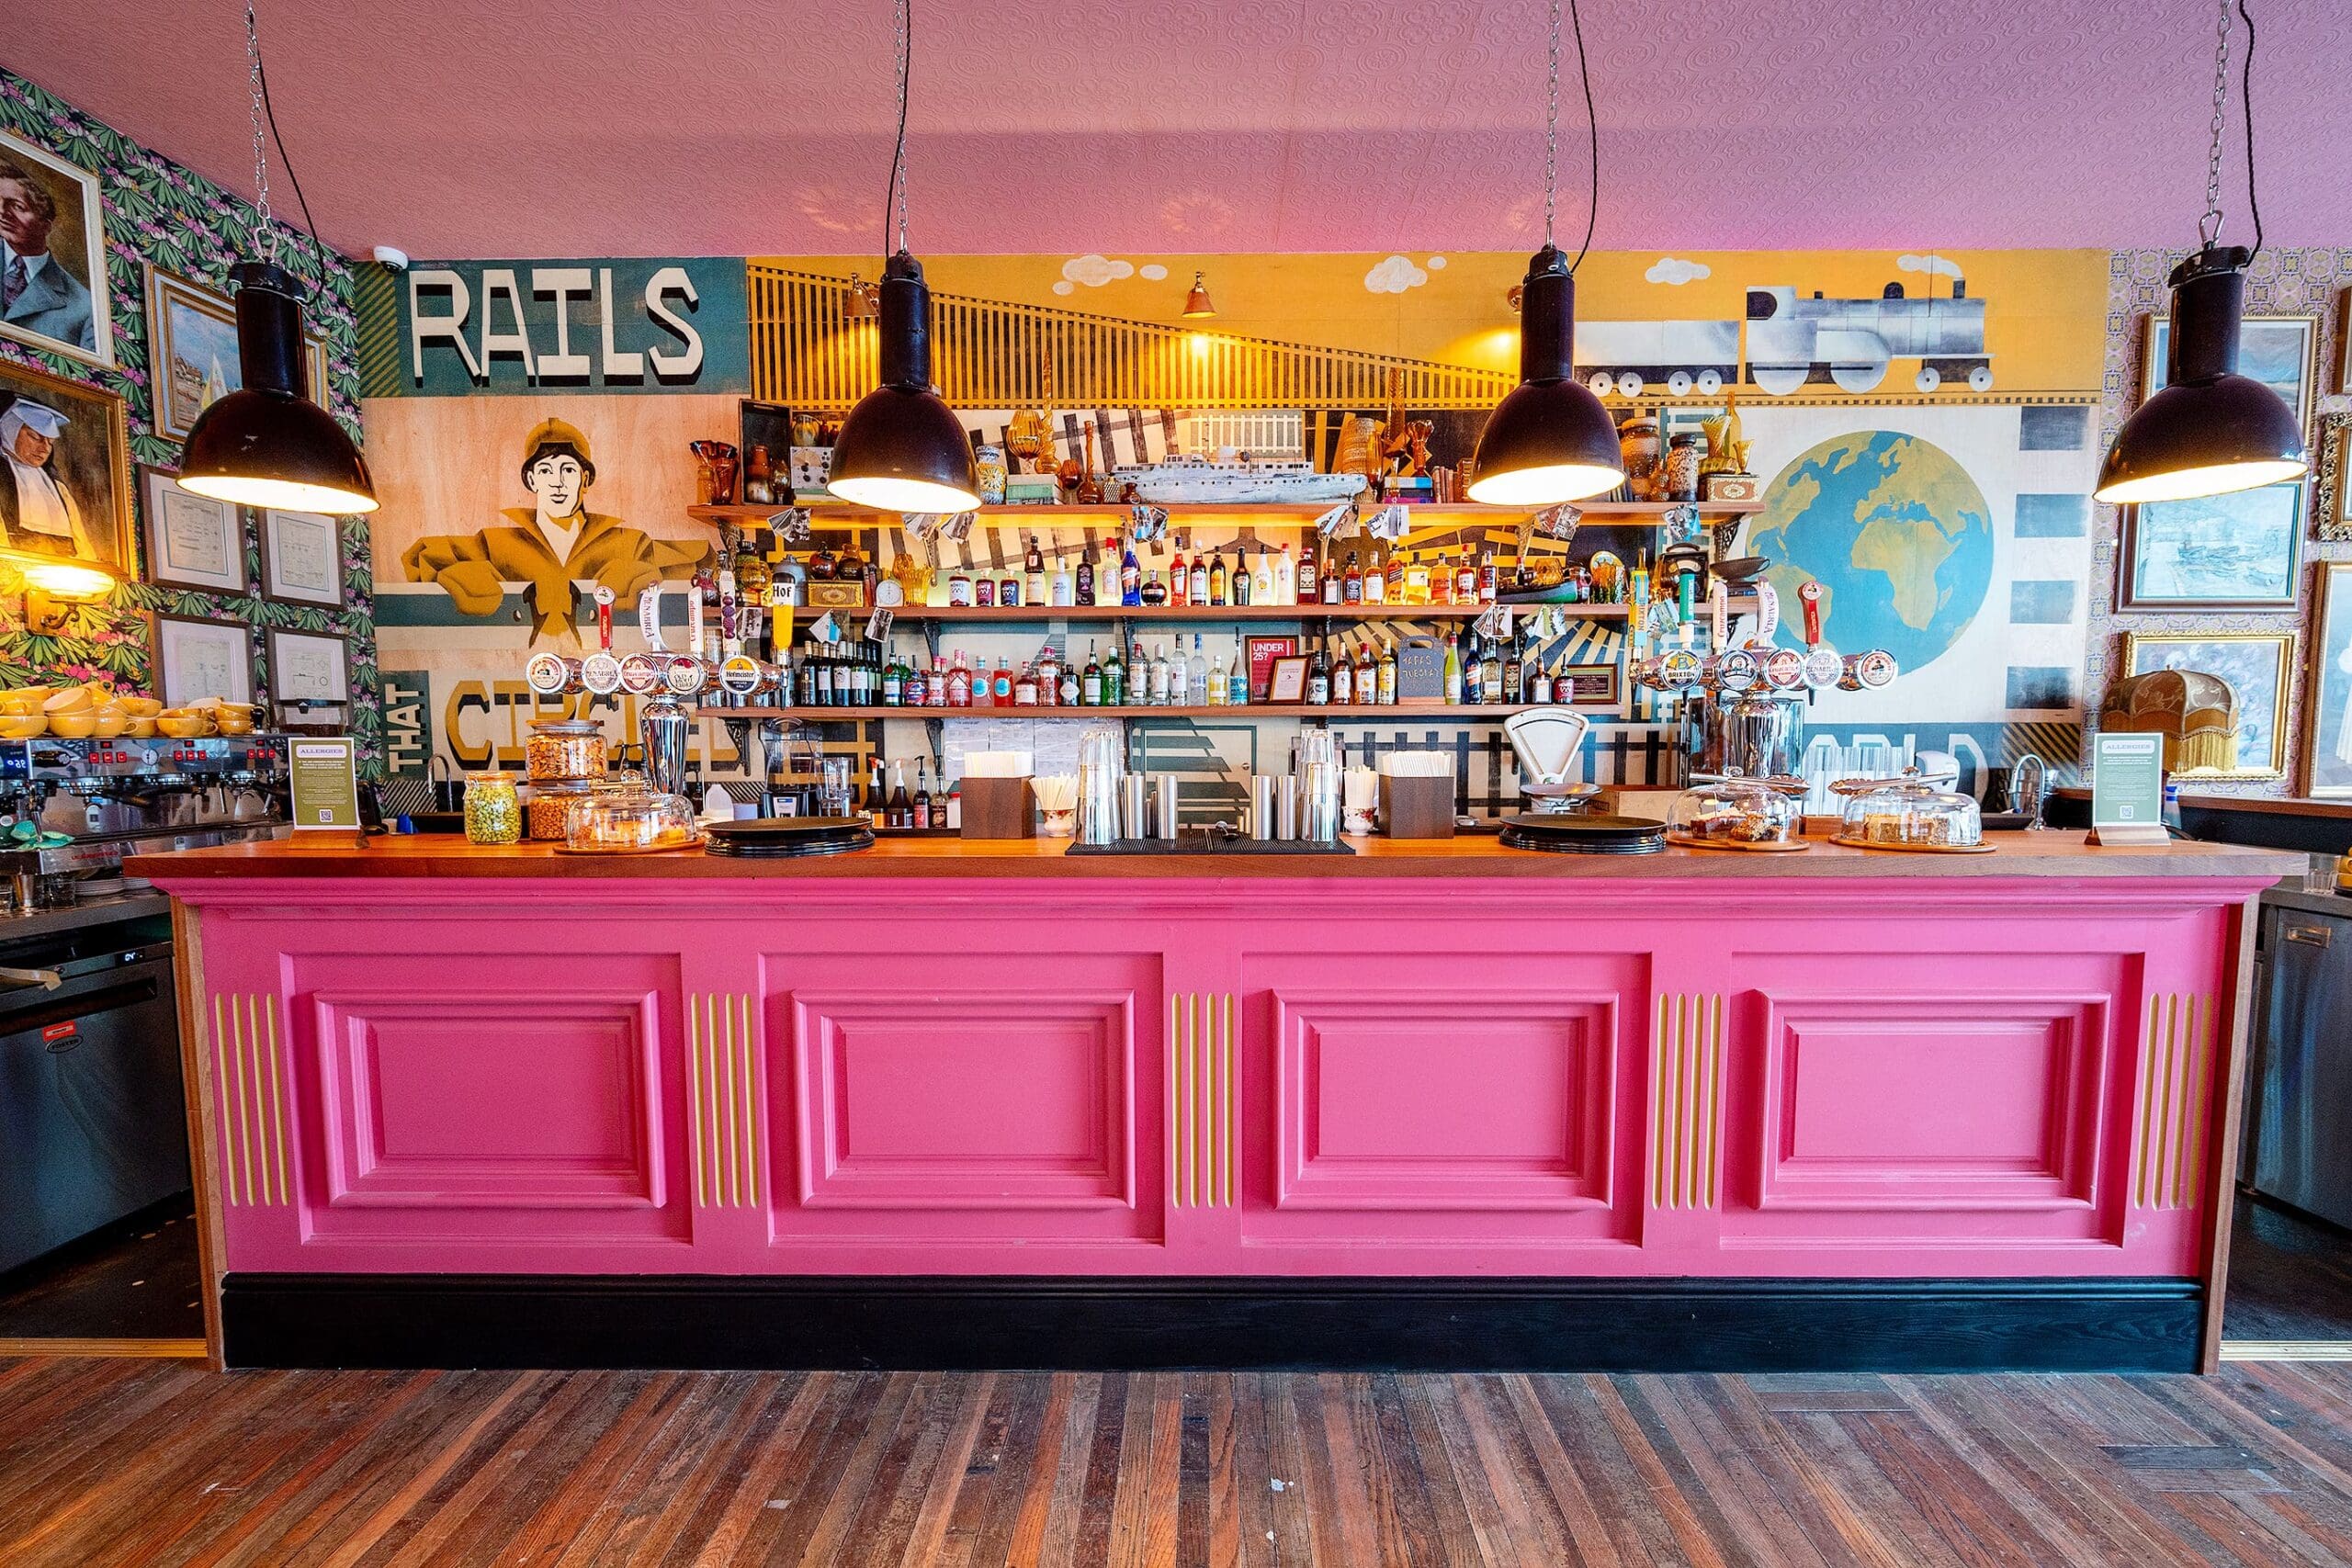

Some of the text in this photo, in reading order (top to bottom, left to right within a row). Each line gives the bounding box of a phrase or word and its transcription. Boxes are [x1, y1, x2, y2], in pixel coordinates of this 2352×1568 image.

[409, 267, 704, 384] RAILS
[1252, 643, 1283, 652] UNDER
[1253, 652, 1268, 661] 25?
[726, 670, 754, 678] Hofmeister
[385, 683, 424, 773] THAT
